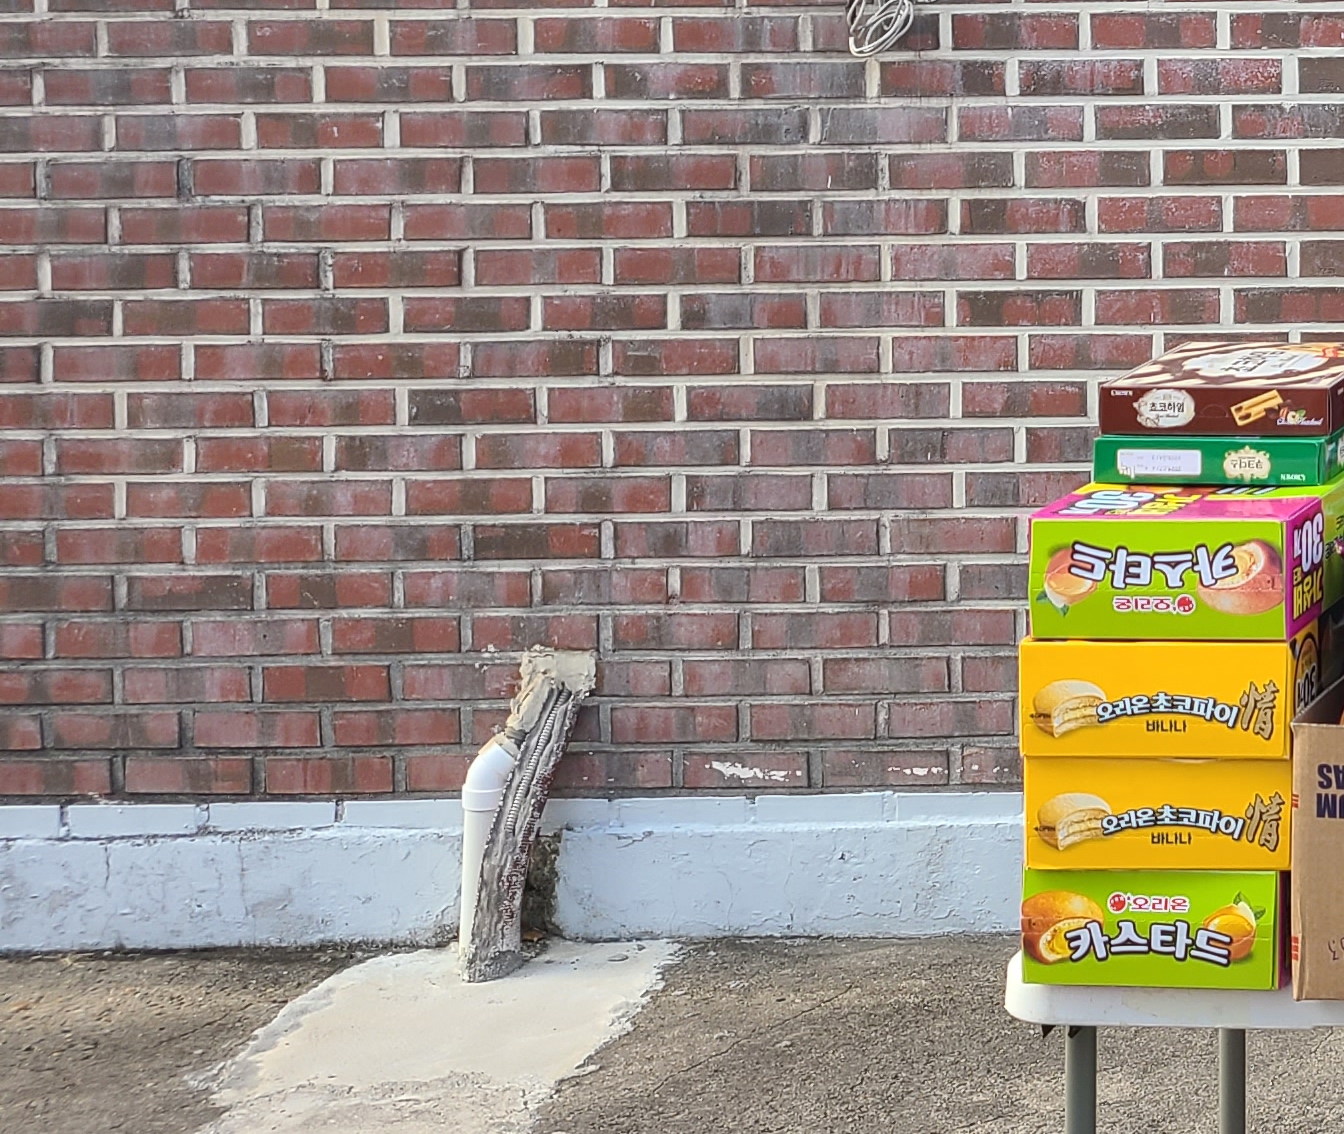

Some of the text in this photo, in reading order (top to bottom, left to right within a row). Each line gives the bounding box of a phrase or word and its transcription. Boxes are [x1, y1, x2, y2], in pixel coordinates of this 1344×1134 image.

[1149, 401, 1186, 413] 초코하임
[1069, 540, 1239, 589] 카스타드
[1113, 595, 1173, 612] 오리온
[1240, 680, 1280, 740] 情
[1146, 720, 1188, 733] 바나나
[1245, 791, 1286, 852] 情
[1151, 832, 1192, 845] 바나나
[1131, 896, 1189, 912] 오리온
[1065, 919, 1233, 967] 카스타드
